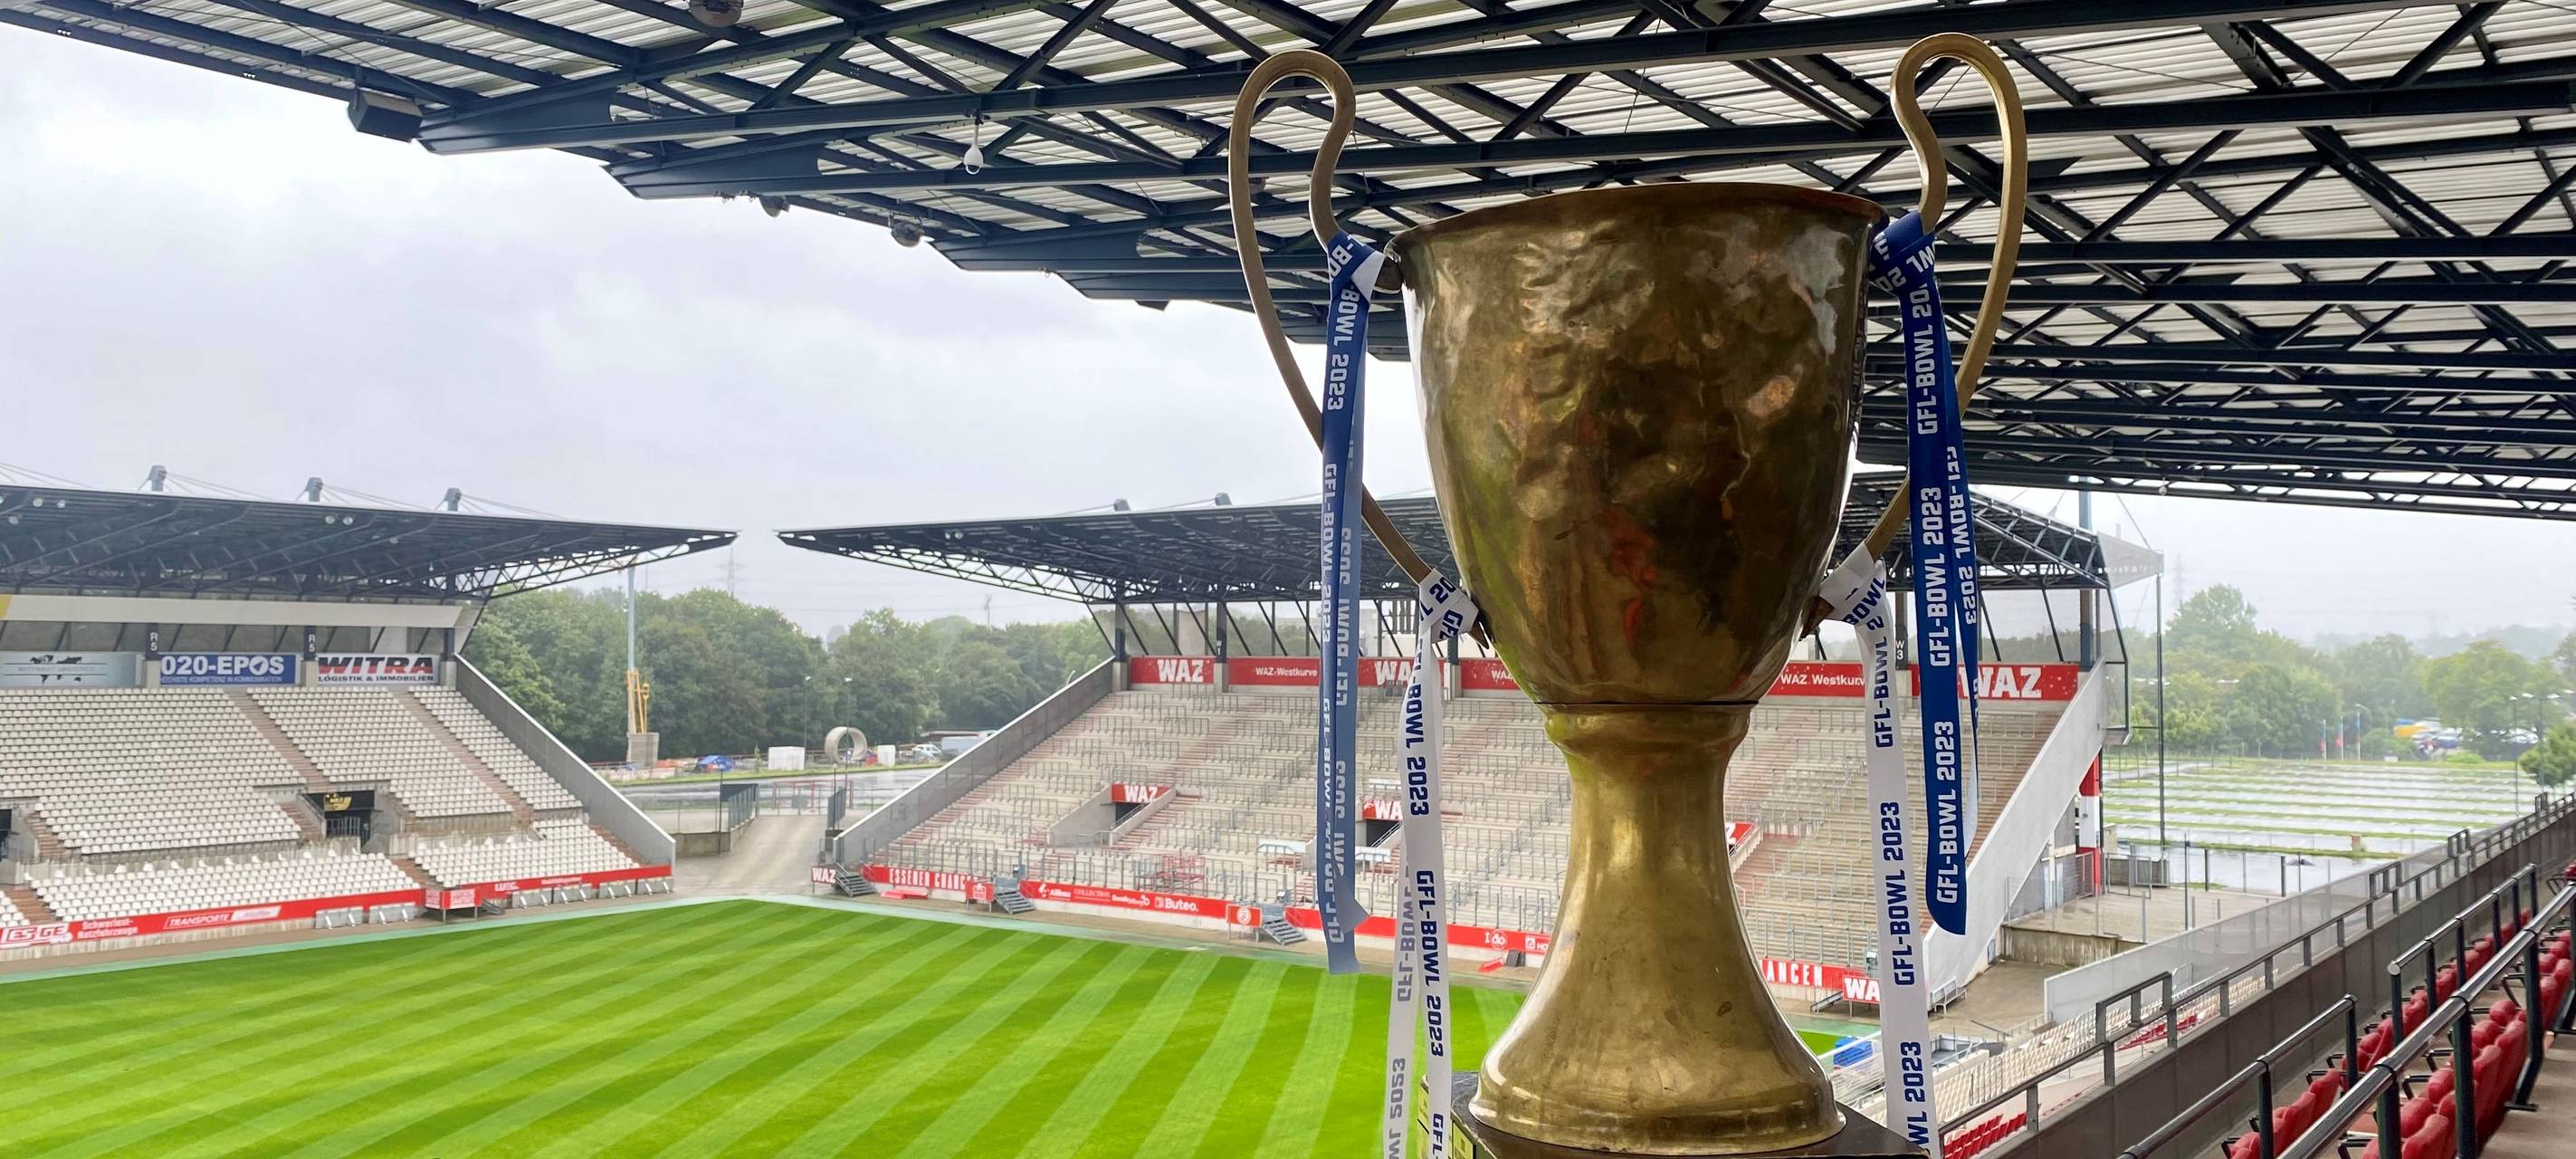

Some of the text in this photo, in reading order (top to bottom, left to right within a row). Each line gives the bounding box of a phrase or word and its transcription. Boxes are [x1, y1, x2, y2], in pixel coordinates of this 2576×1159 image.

[1327, 354, 1349, 411] 2023
[1913, 324, 1938, 436] GFL-BOWL
[1921, 487, 1951, 666] GFL-BOWL 2023
[1842, 577, 1885, 626] BOWL
[1958, 565, 1977, 625] 2023
[319, 657, 434, 674] WITRA
[1157, 659, 1204, 683] WAZ
[1255, 667, 1318, 677] WAZ-Westkurve
[1374, 661, 1414, 685] WA
[1812, 674, 1865, 685] Westkurv
[1874, 637, 1894, 748] GFL-BOWL
[1958, 666, 2042, 698] WAZ
[1123, 785, 1158, 803] WAZ
[1407, 757, 1430, 816] 2023
[1375, 800, 1403, 819] WA
[1934, 721, 1958, 904] GFL-BOWL 2023
[812, 867, 836, 884] WAZ
[889, 868, 978, 891] ESSENER CHANC
[1880, 801, 1915, 985] GFL-BOWL 2023
[169, 913, 230, 926] TRANSPORTE
[1417, 870, 1444, 1058] GFL-BOWL 2023
[1761, 960, 1823, 987] ANCEN
[1844, 977, 1880, 1001] WA
[1901, 1041, 1926, 1103] 2023
